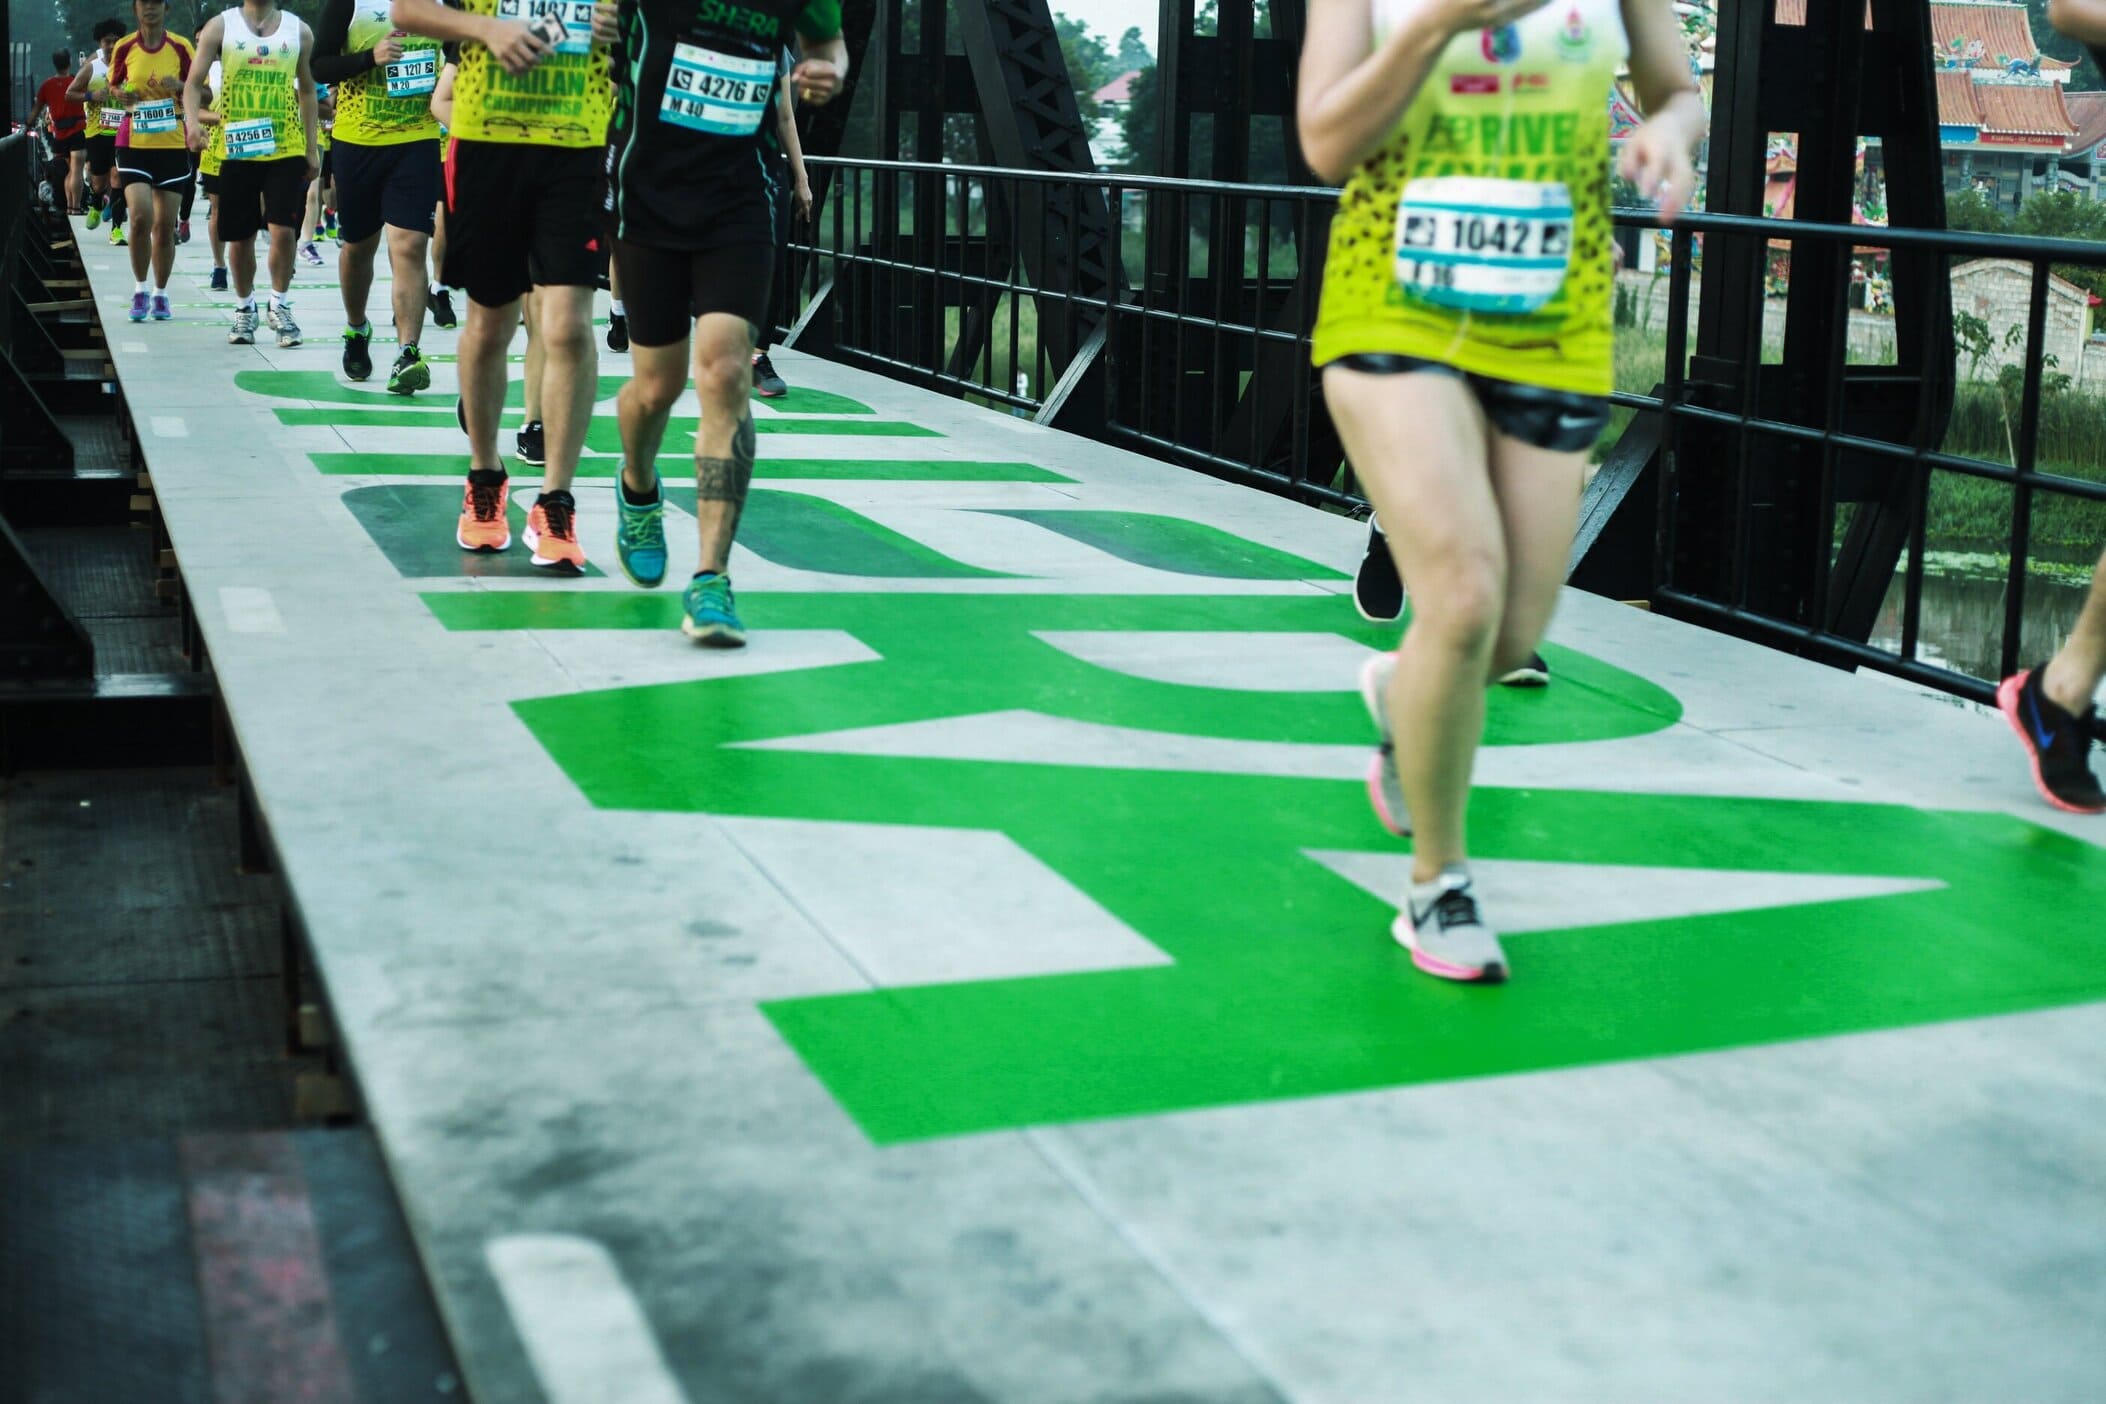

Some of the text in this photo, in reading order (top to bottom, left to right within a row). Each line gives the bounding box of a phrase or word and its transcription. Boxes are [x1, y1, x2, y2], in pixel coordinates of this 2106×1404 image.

[696, 0, 780, 39] SHERA
[404, 63, 422, 76] 1217
[391, 80, 410, 90] M 20
[699, 75, 748, 102] 4276
[669, 97, 705, 118] M 40
[235, 129, 260, 142] 4256
[1453, 218, 1530, 254] 1042
